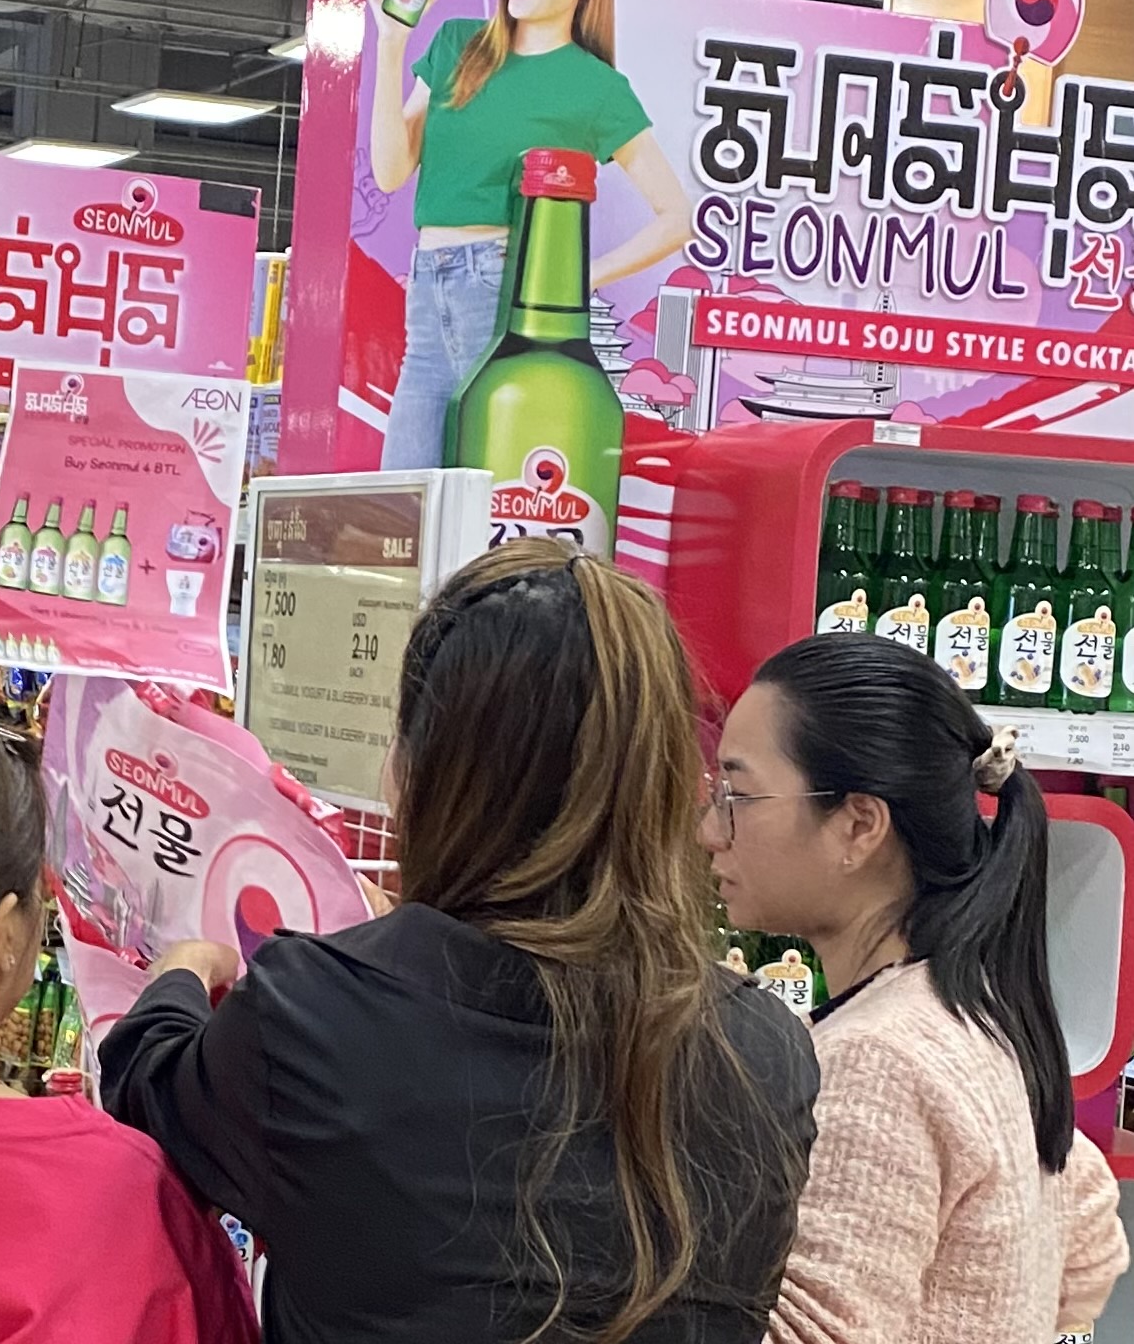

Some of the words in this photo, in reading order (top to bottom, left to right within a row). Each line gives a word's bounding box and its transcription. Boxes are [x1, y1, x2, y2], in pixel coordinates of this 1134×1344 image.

[81, 208, 177, 242] SEONMUL
[688, 196, 1025, 296] SEONMUL
[707, 309, 850, 347] SEONMUL
[863, 323, 934, 354] SOJU
[947, 331, 1024, 362] STYLE
[68, 435, 115, 449] SPECIAL
[118, 439, 187, 455] PROMOTION
[65, 456, 86, 471] Buy
[90, 459, 140, 474] Seonmul
[491, 494, 582, 520] SEONMUL
[382, 537, 414, 559] SALE
[264, 591, 296, 617] 7,500
[352, 632, 378, 661] 2.10
[948, 626, 989, 652] 선물
[1013, 628, 1053, 656] 선물
[1074, 634, 1115, 660] 선물
[262, 641, 286, 669] 1.80
[109, 752, 203, 817] SEONMUL
